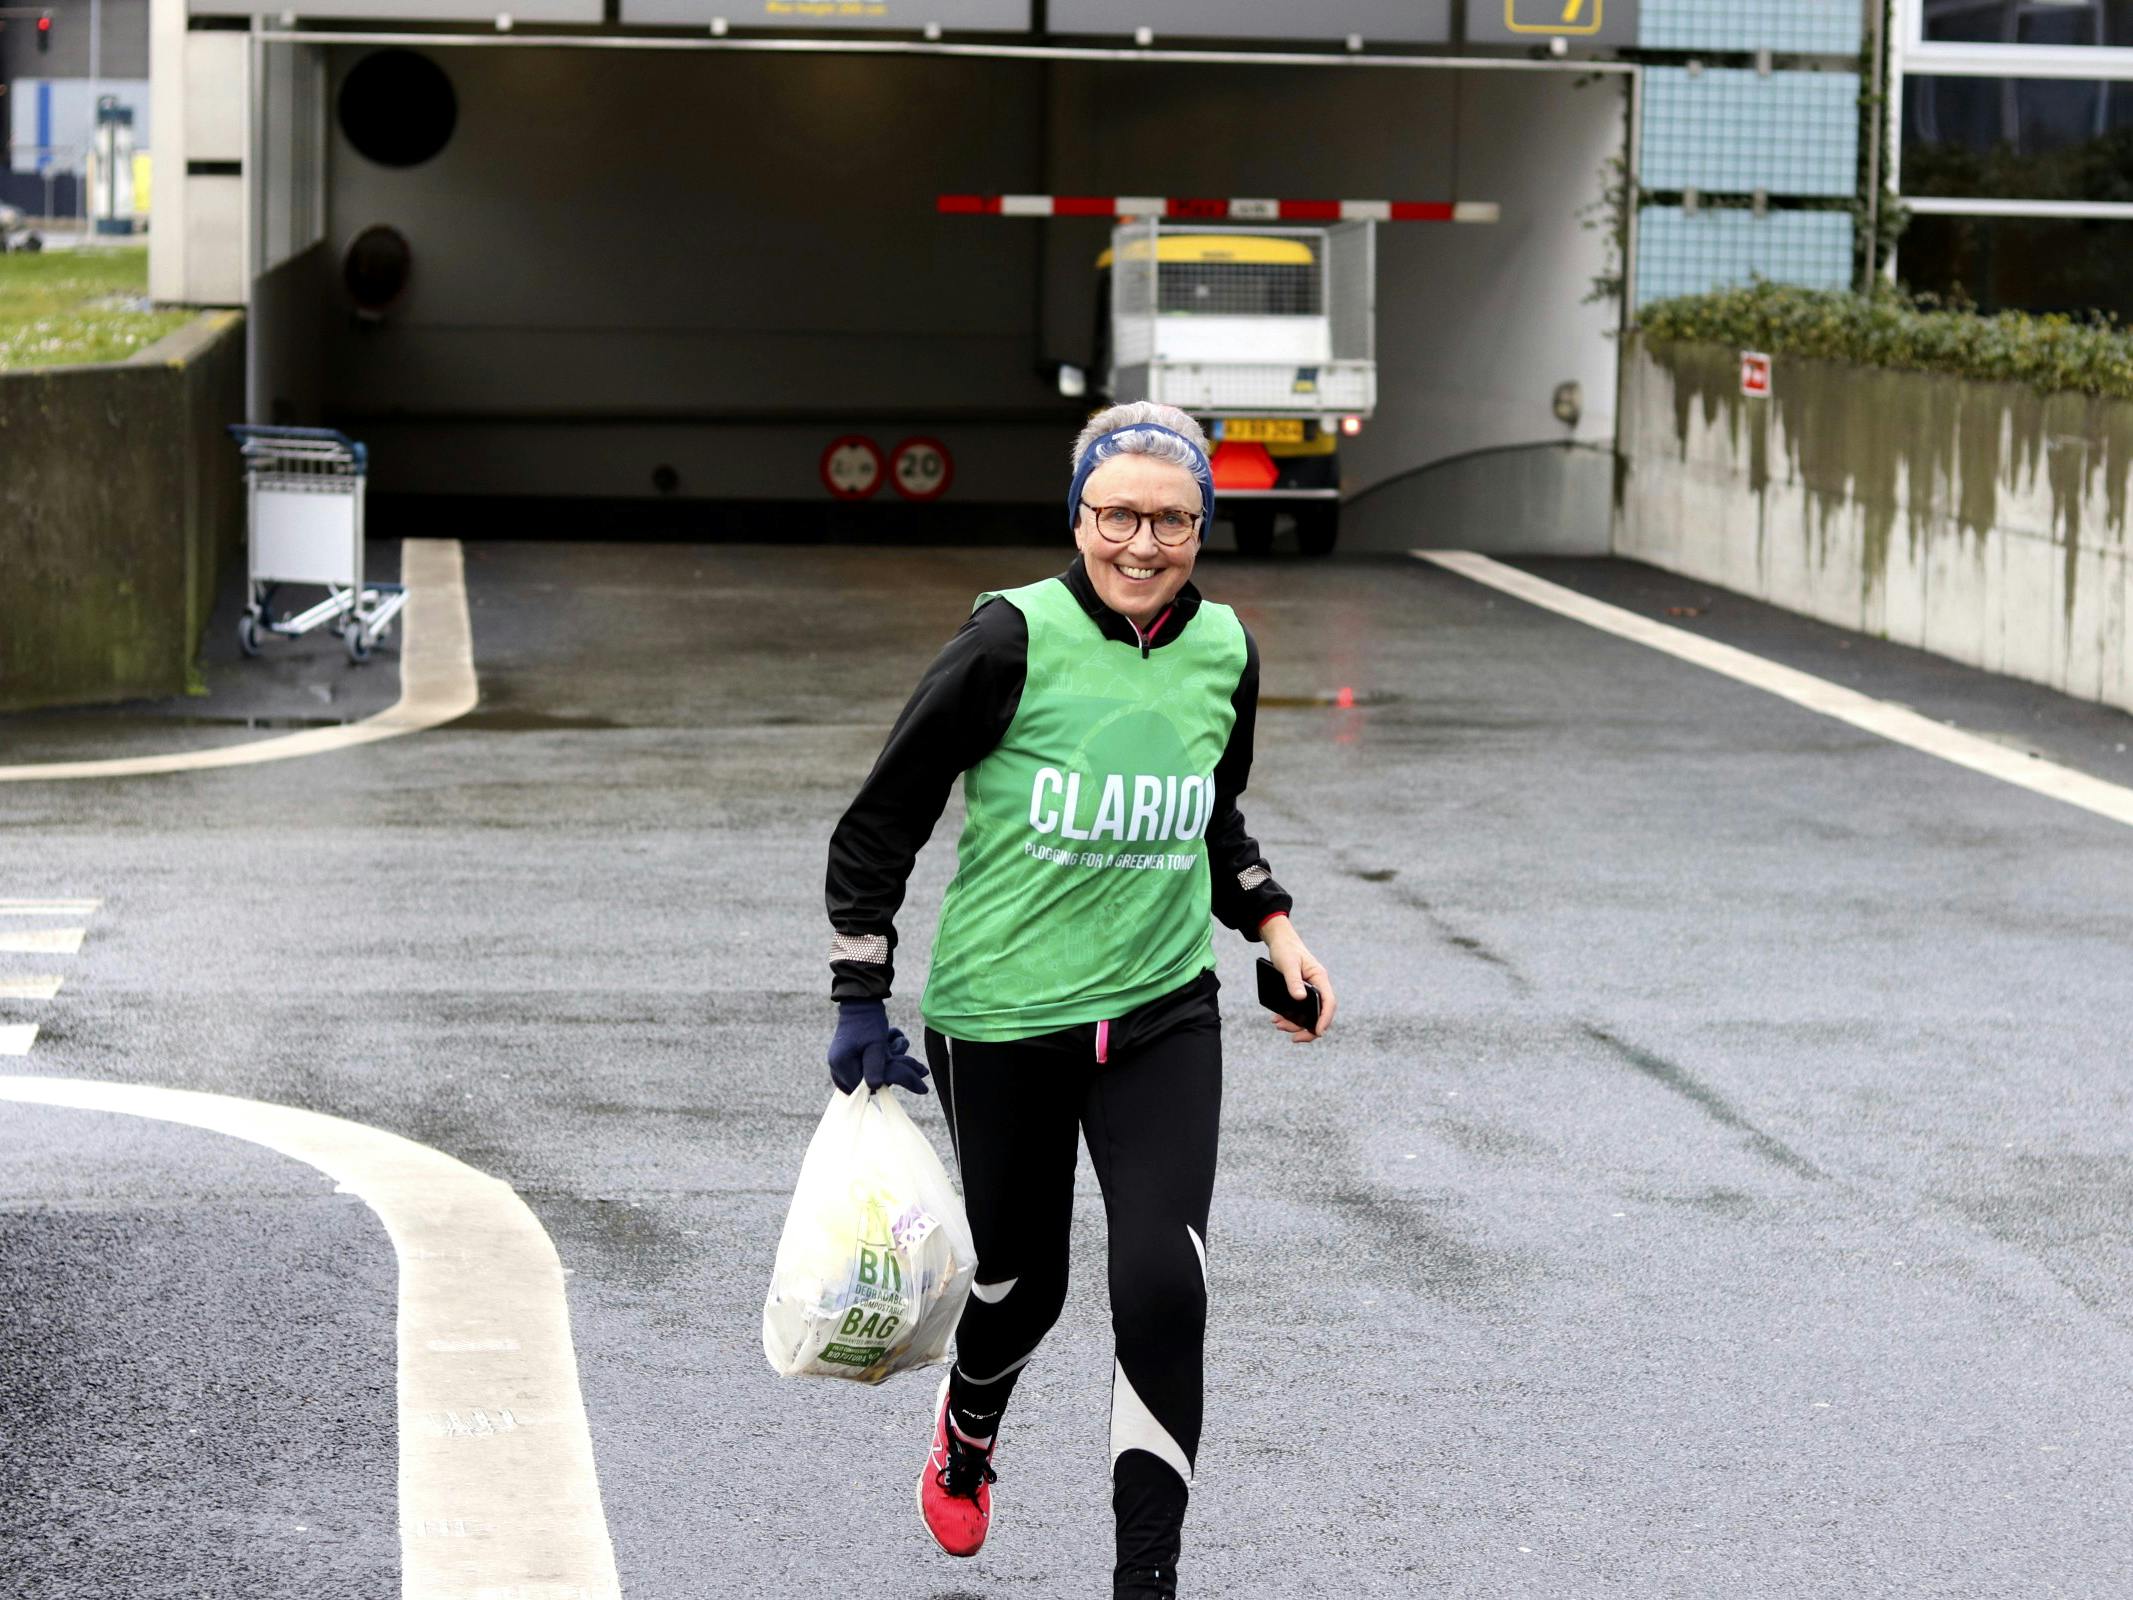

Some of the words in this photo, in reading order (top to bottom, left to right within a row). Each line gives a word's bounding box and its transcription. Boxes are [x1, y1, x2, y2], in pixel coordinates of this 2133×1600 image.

[902, 452, 941, 478] 20
[1025, 842, 1079, 866] PLOGGING
[1079, 852, 1104, 869] FOR
[1105, 854, 1114, 869] A
[1115, 854, 1164, 871] GREENER
[840, 1307, 899, 1339] BAG
